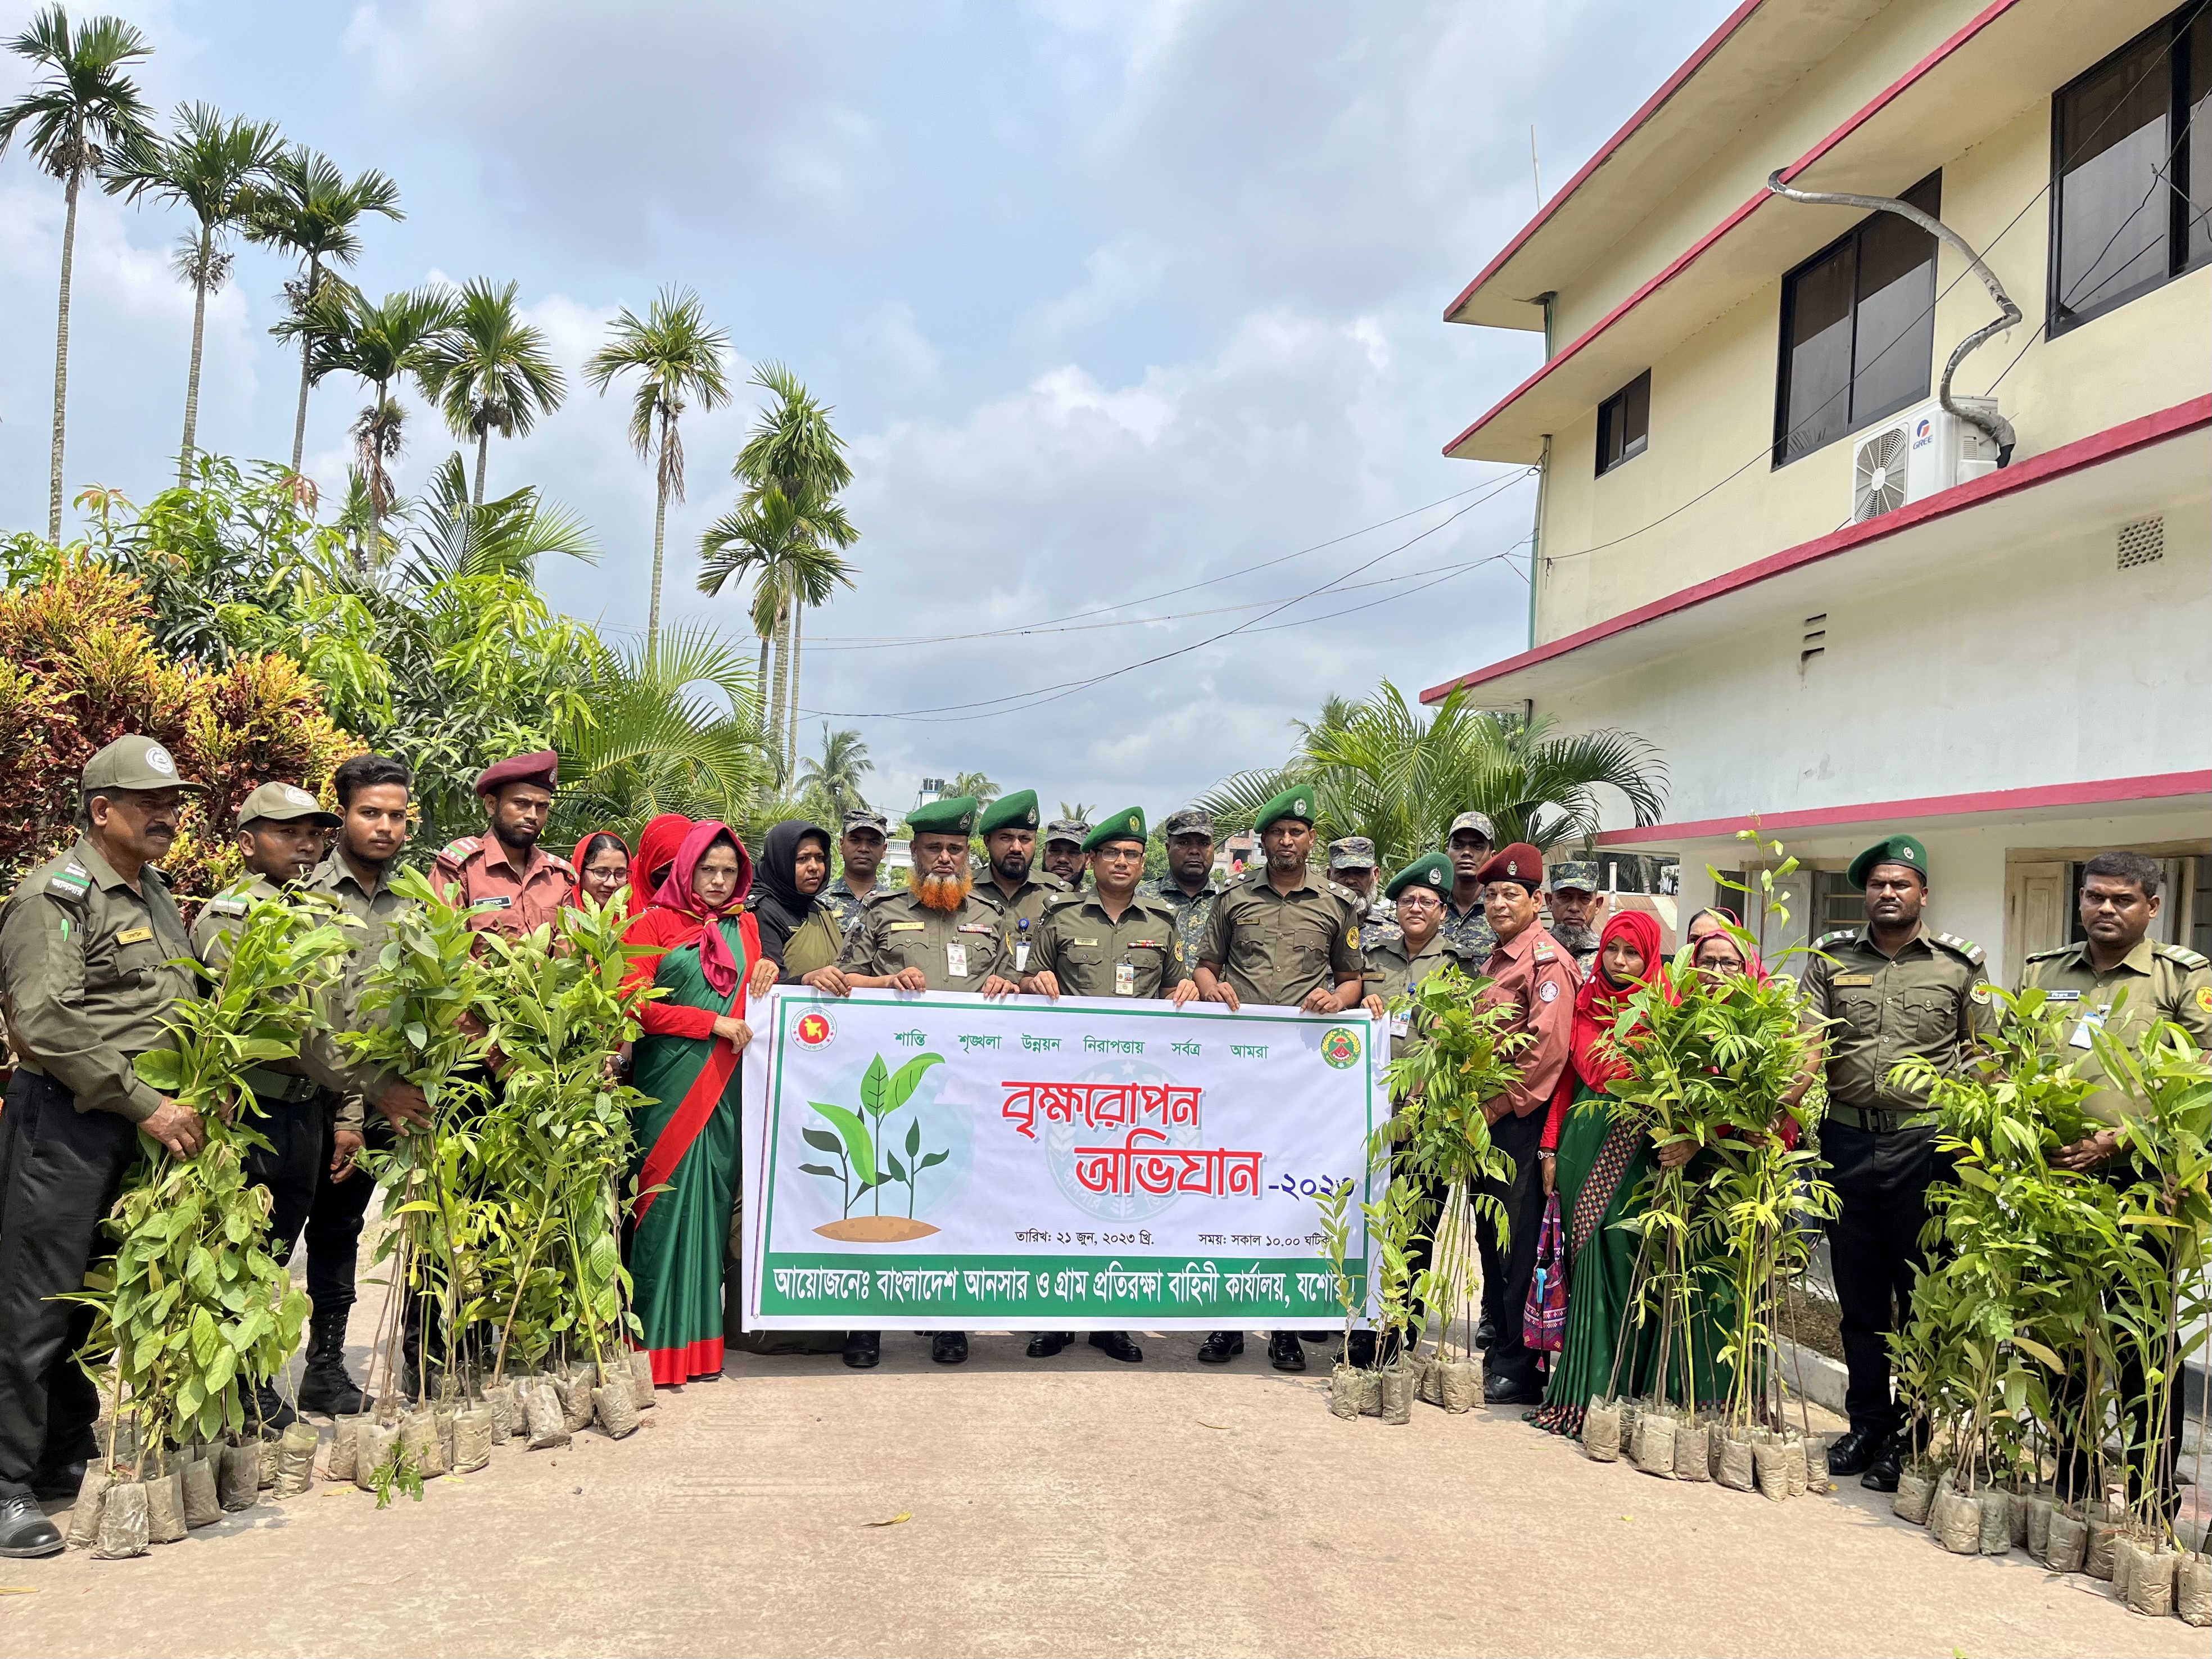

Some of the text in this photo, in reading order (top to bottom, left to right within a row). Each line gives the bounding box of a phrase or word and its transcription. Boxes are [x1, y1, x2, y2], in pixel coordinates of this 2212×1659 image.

[1913, 435, 1933, 450] GREE
[894, 1029, 1269, 1060] শান্তি শৃঙ্খলা উন্নয়ন নিরাপত্তায় সর্বত্র আমরা
[1001, 1081, 1203, 1139] বৃক্ষরোপন
[1074, 1128, 1263, 1196] অভিযান
[1057, 1232, 1071, 1244] ২১
[1075, 1232, 1098, 1246] জুন,
[1102, 1232, 1136, 1245] ২০২৩
[1138, 1229, 1154, 1246] খ্রি.
[1231, 1234, 1263, 1246] সকাল
[1266, 1236, 1300, 1247] ১০.০০
[1304, 1232, 1335, 1246] ঘটিক
[875, 1266, 960, 1303] বাংলাদেশ
[963, 1267, 1031, 1301] আনসার
[1035, 1272, 1050, 1298] ও
[1054, 1266, 1090, 1303] গ্রাম
[1093, 1260, 1164, 1303] প্রতিরক্ষা
[1167, 1260, 1221, 1307] বাহিনী
[1223, 1262, 1290, 1308] কার্যালয়,
